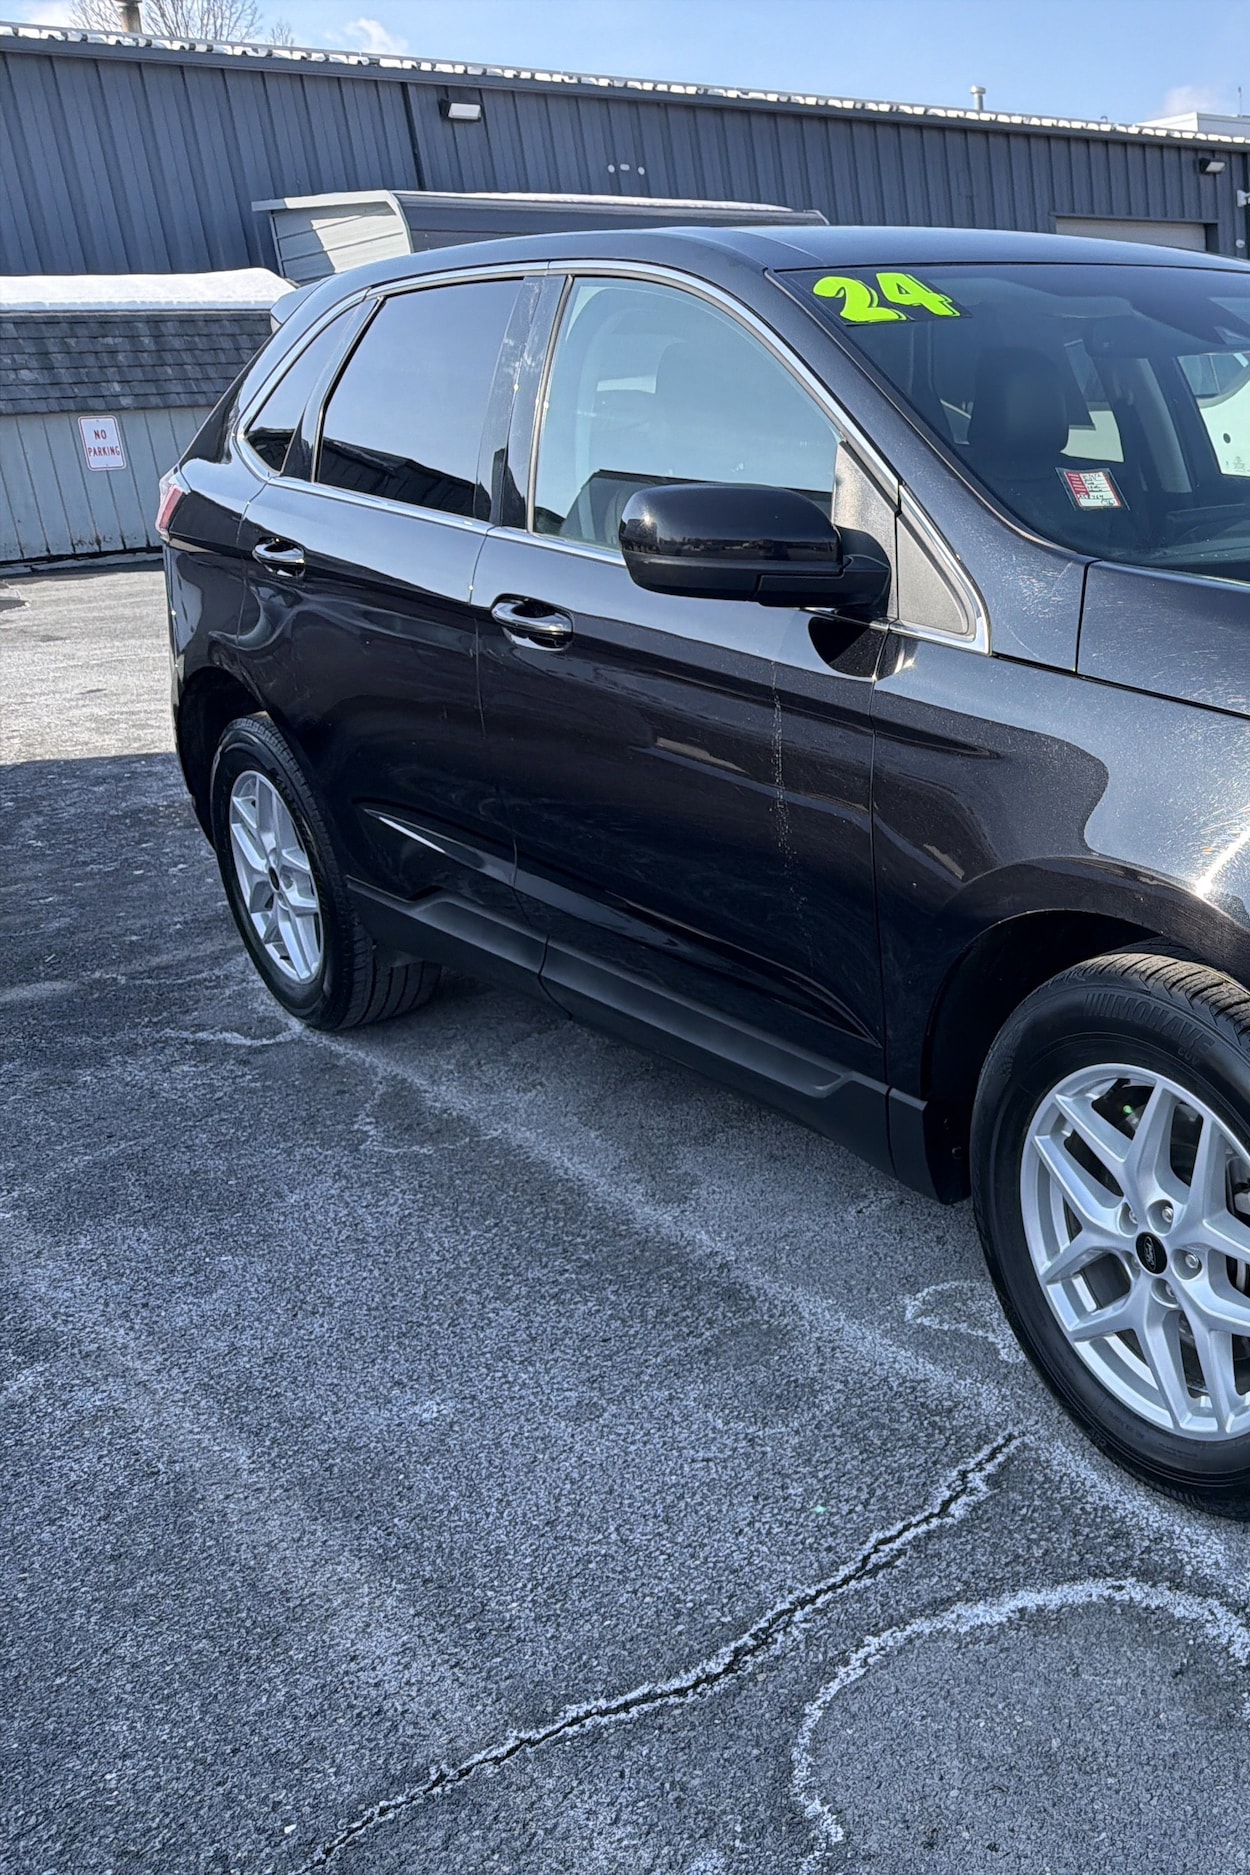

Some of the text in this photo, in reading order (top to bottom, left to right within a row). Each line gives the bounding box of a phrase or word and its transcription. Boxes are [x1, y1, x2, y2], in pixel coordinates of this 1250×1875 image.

[813, 272, 960, 322] 24
[93, 429, 107, 440] NO
[87, 446, 120, 457] PARKING
